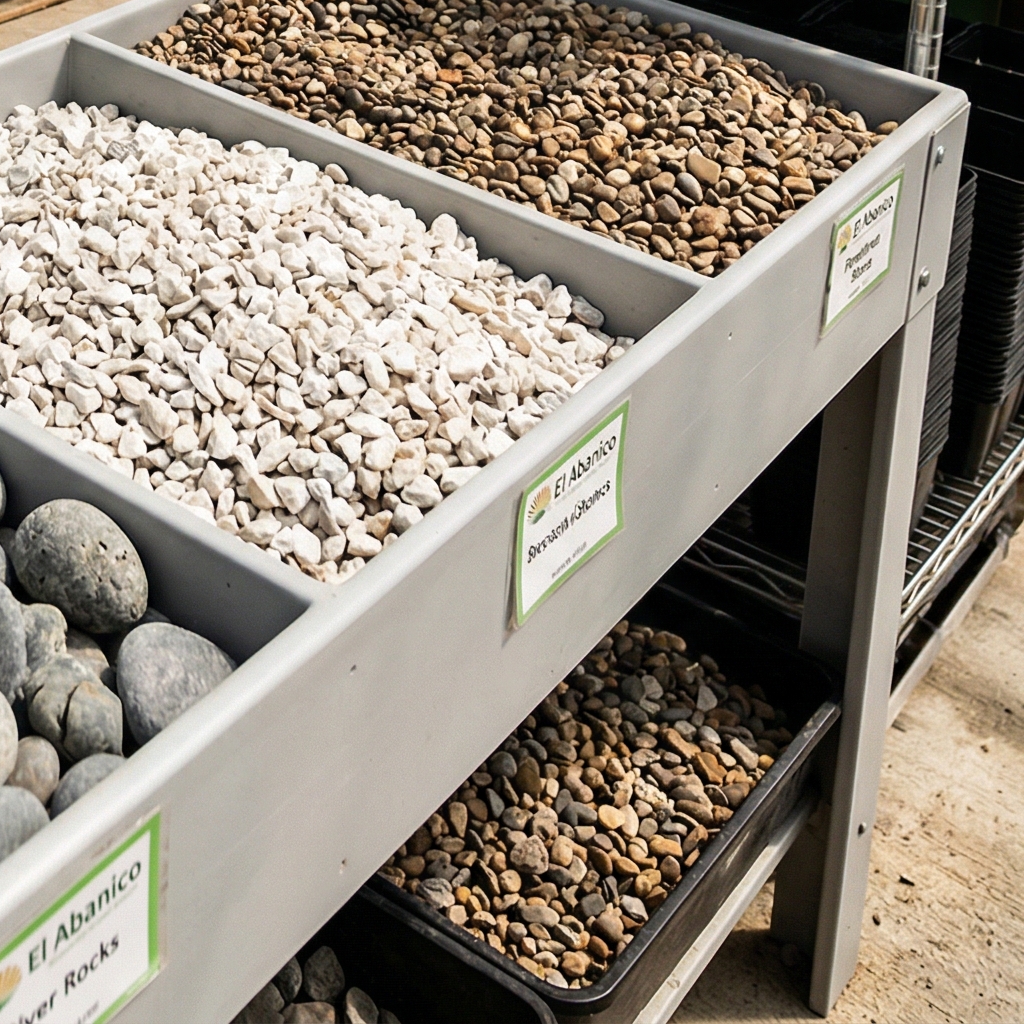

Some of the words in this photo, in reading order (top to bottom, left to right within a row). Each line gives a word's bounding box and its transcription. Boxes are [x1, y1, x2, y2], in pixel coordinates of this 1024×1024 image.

[554, 473, 566, 500] El
[568, 434, 617, 487] Abanico
[29, 936, 47, 974] El
[54, 861, 142, 951] Abanico
[64, 933, 120, 996] Rocks
